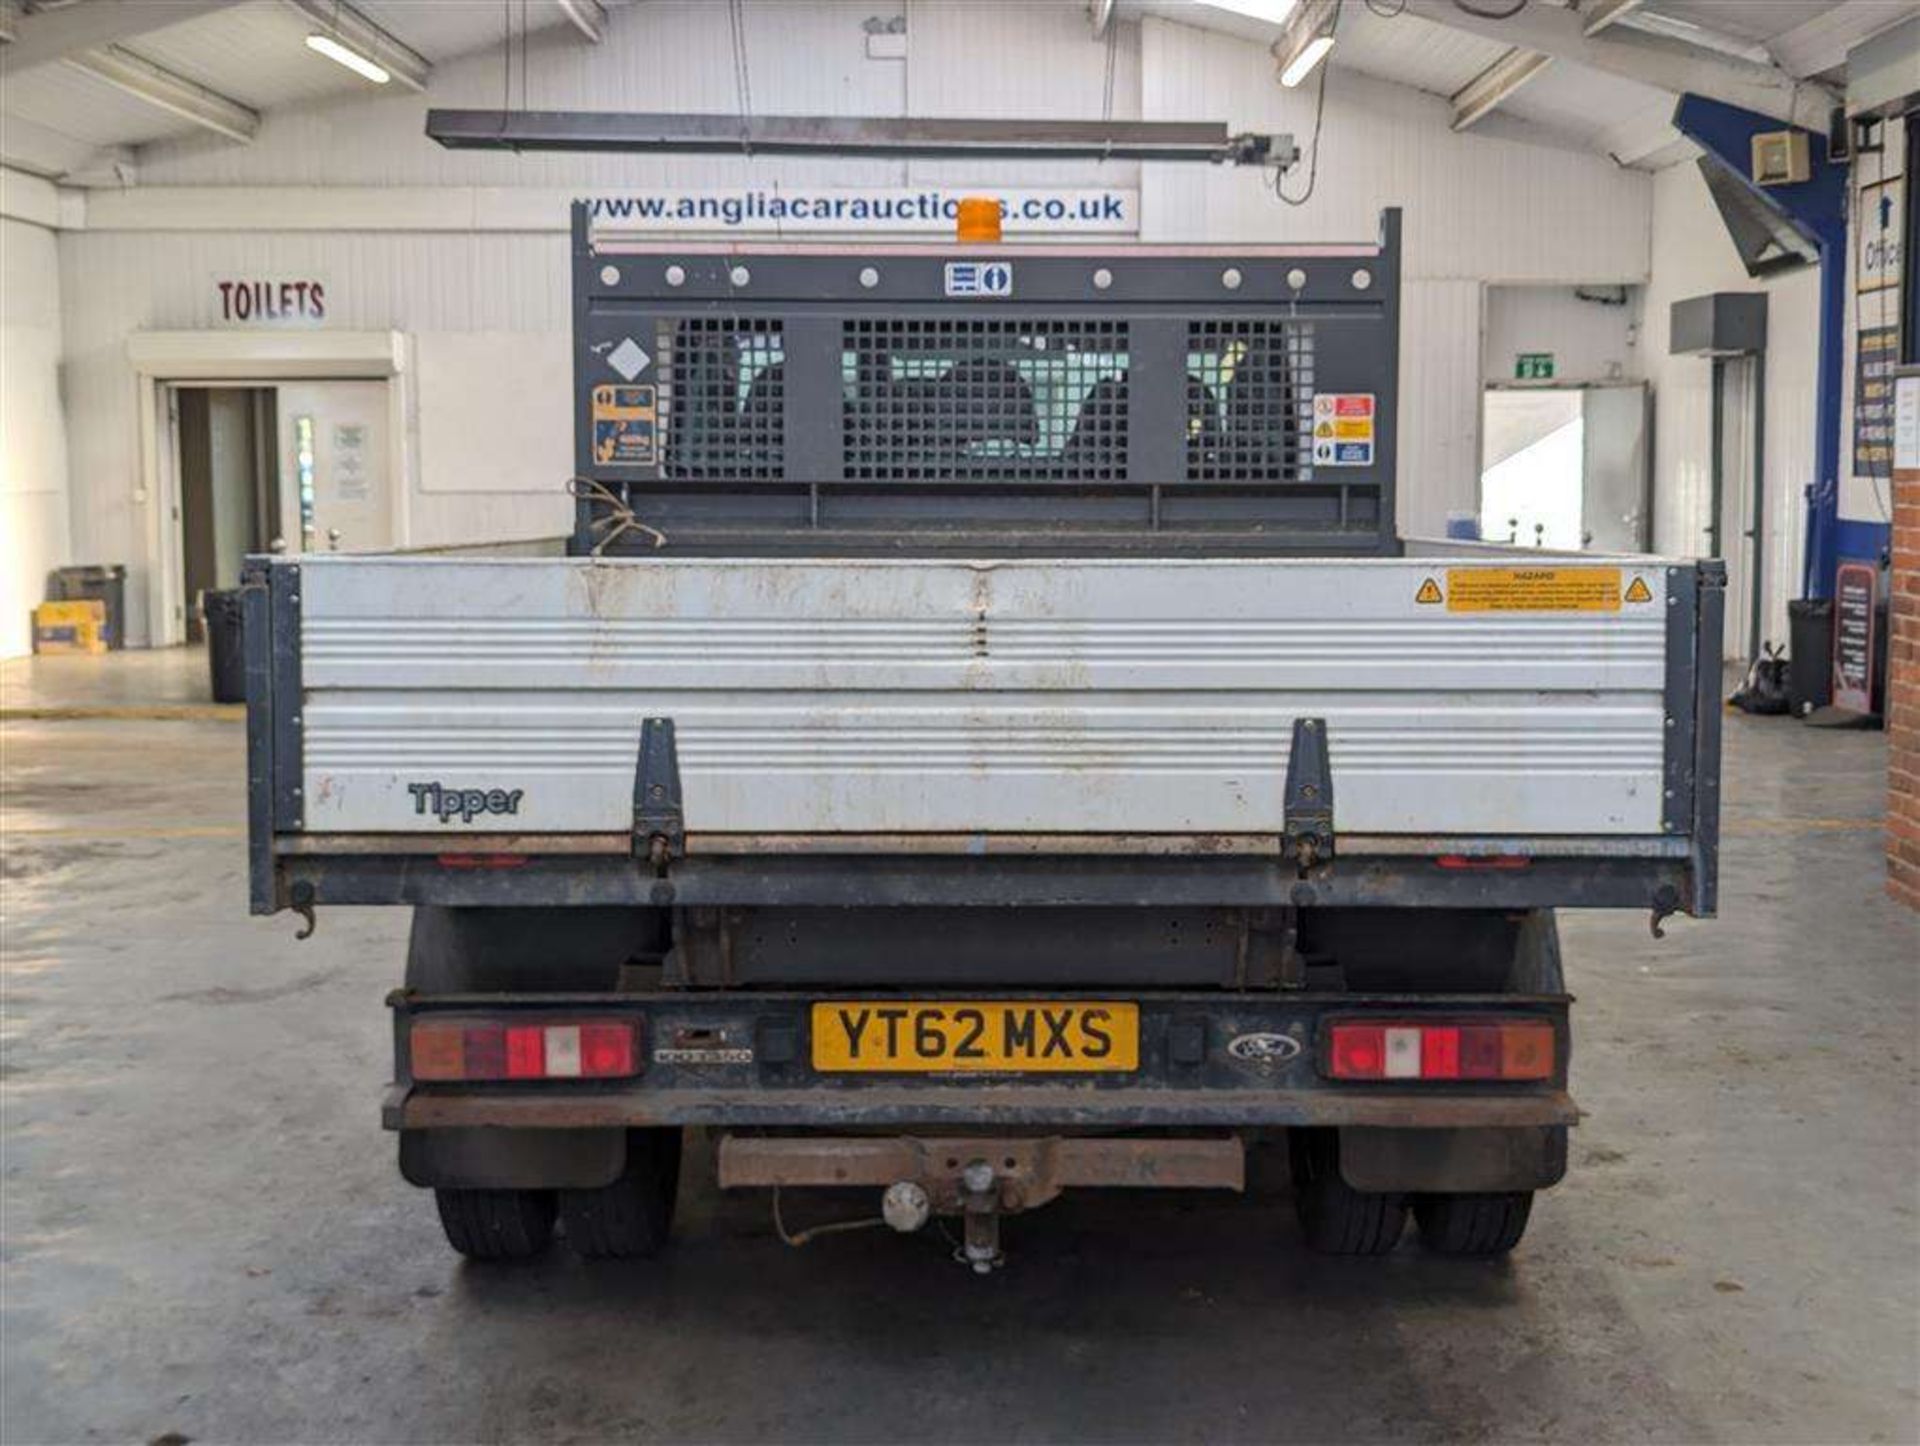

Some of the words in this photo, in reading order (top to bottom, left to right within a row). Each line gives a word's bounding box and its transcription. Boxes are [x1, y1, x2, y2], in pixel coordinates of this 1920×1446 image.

[218, 280, 325, 321] TOILETS
[407, 781, 525, 824] Tipper
[838, 1008, 987, 1060] YT62
[1003, 1008, 1113, 1060] MXS
